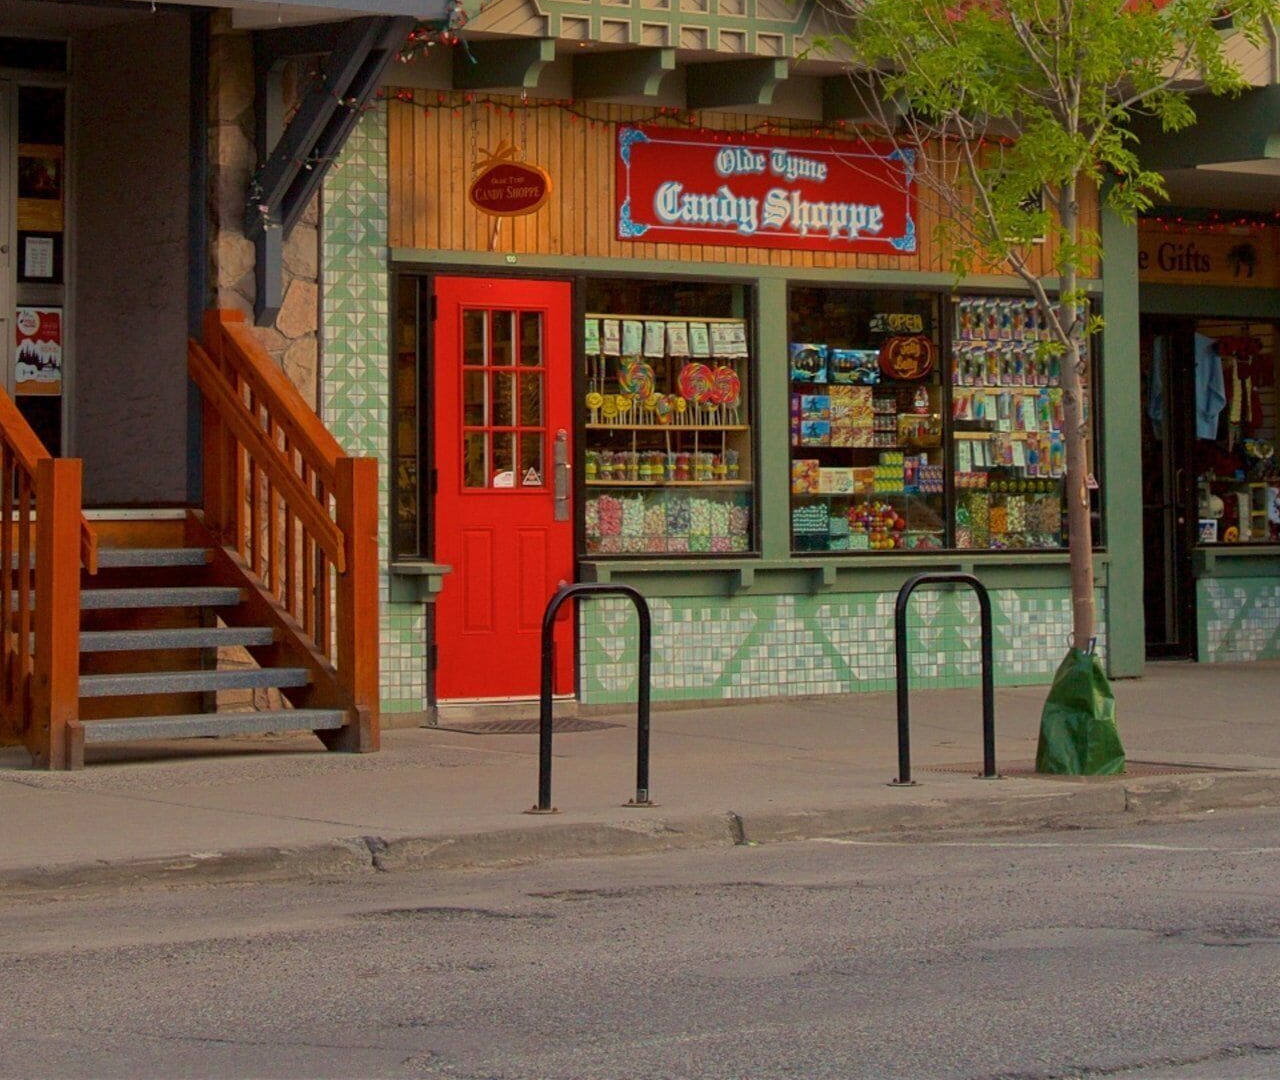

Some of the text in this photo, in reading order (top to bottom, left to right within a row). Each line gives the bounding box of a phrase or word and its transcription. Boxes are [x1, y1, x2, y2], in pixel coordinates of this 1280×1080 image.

[715, 146, 828, 182] Olde Tyme
[654, 180, 885, 240] Candy Shoppe
[1158, 241, 1211, 274] Gifts
[888, 314, 923, 330] OPEN
